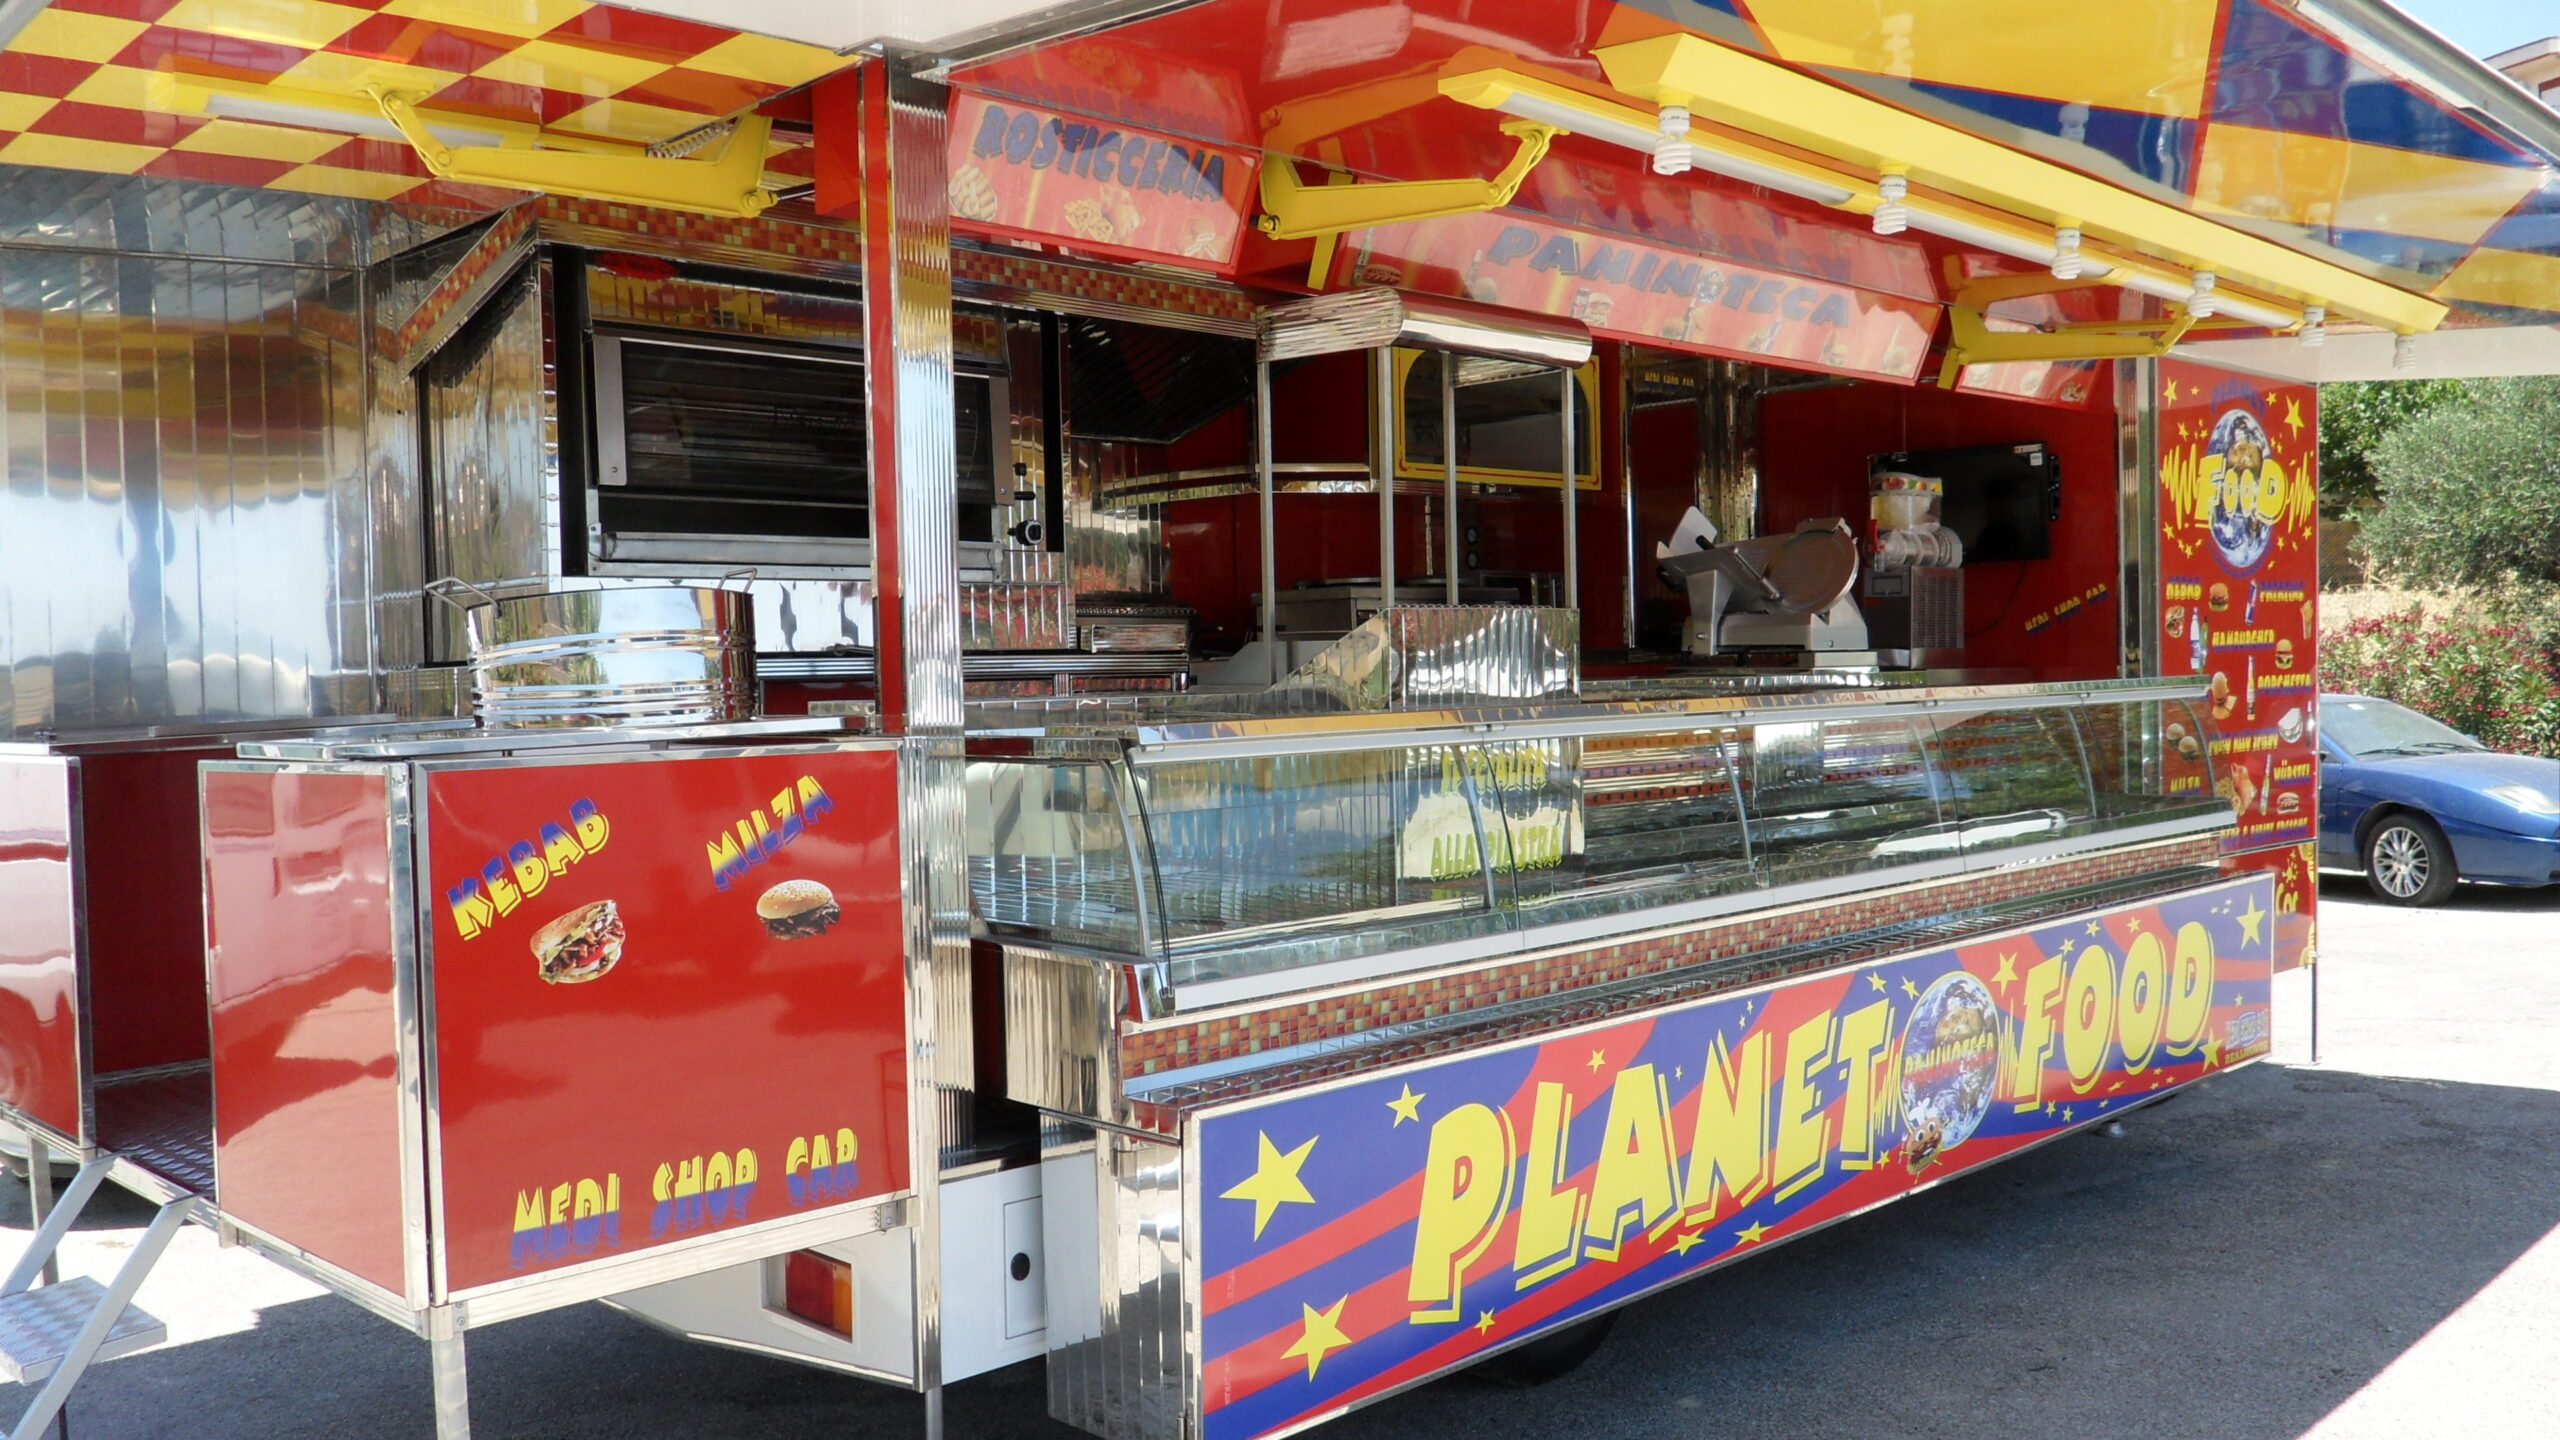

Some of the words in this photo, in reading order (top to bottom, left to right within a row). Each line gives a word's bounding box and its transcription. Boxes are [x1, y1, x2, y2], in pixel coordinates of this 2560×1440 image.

[973, 104, 1225, 202] ROSTICCERIA
[2194, 453, 2289, 529] FOOD
[447, 797, 610, 941] KEBAB
[706, 775, 834, 892] MILZA
[1431, 833, 1479, 880] ALLA
[1484, 825, 1563, 875] PIASTRA
[1407, 998, 1895, 1324] PLANET
[2013, 921, 2215, 1114] FOOD
[510, 1173, 620, 1269] MEDI
[648, 1147, 758, 1239] SHOP
[784, 1127, 860, 1207] CAR
